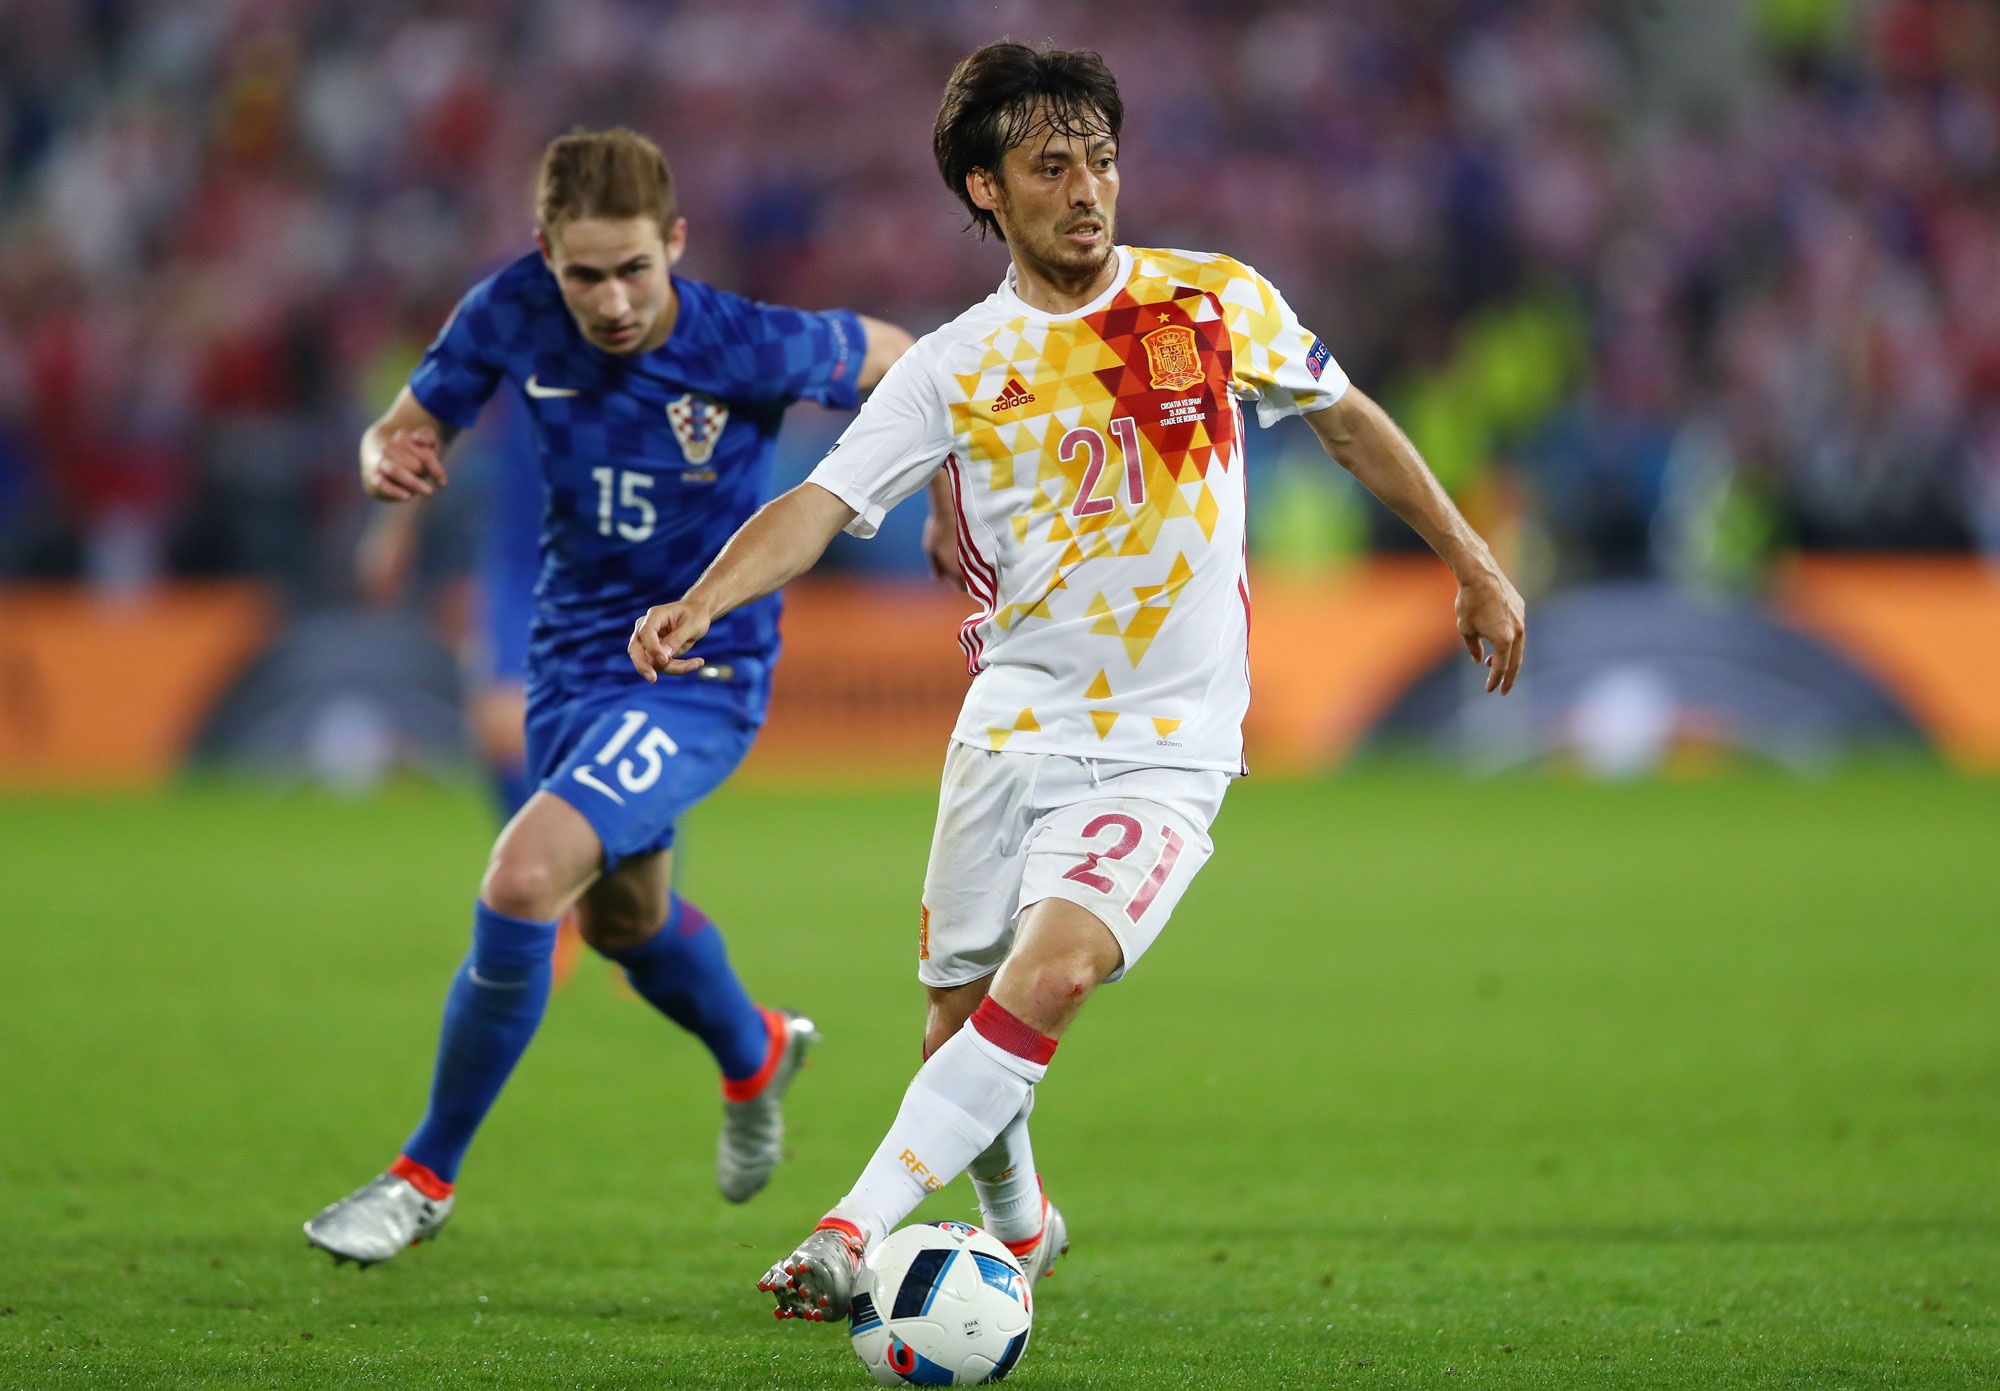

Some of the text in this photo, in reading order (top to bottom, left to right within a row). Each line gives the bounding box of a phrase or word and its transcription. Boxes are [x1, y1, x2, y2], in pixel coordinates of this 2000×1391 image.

[991, 394, 1035, 412] adidas
[1160, 401, 1181, 410] CROATIA
[1160, 417, 1176, 426] STADE
[1183, 413, 1205, 422] BORDEAUX
[1058, 416, 1145, 518] 21
[592, 466, 657, 542] 15
[594, 710, 679, 793] 15
[1156, 739, 1183, 748] adizero
[1061, 813, 1185, 925] 21
[964, 1320, 978, 1328] FIFA
